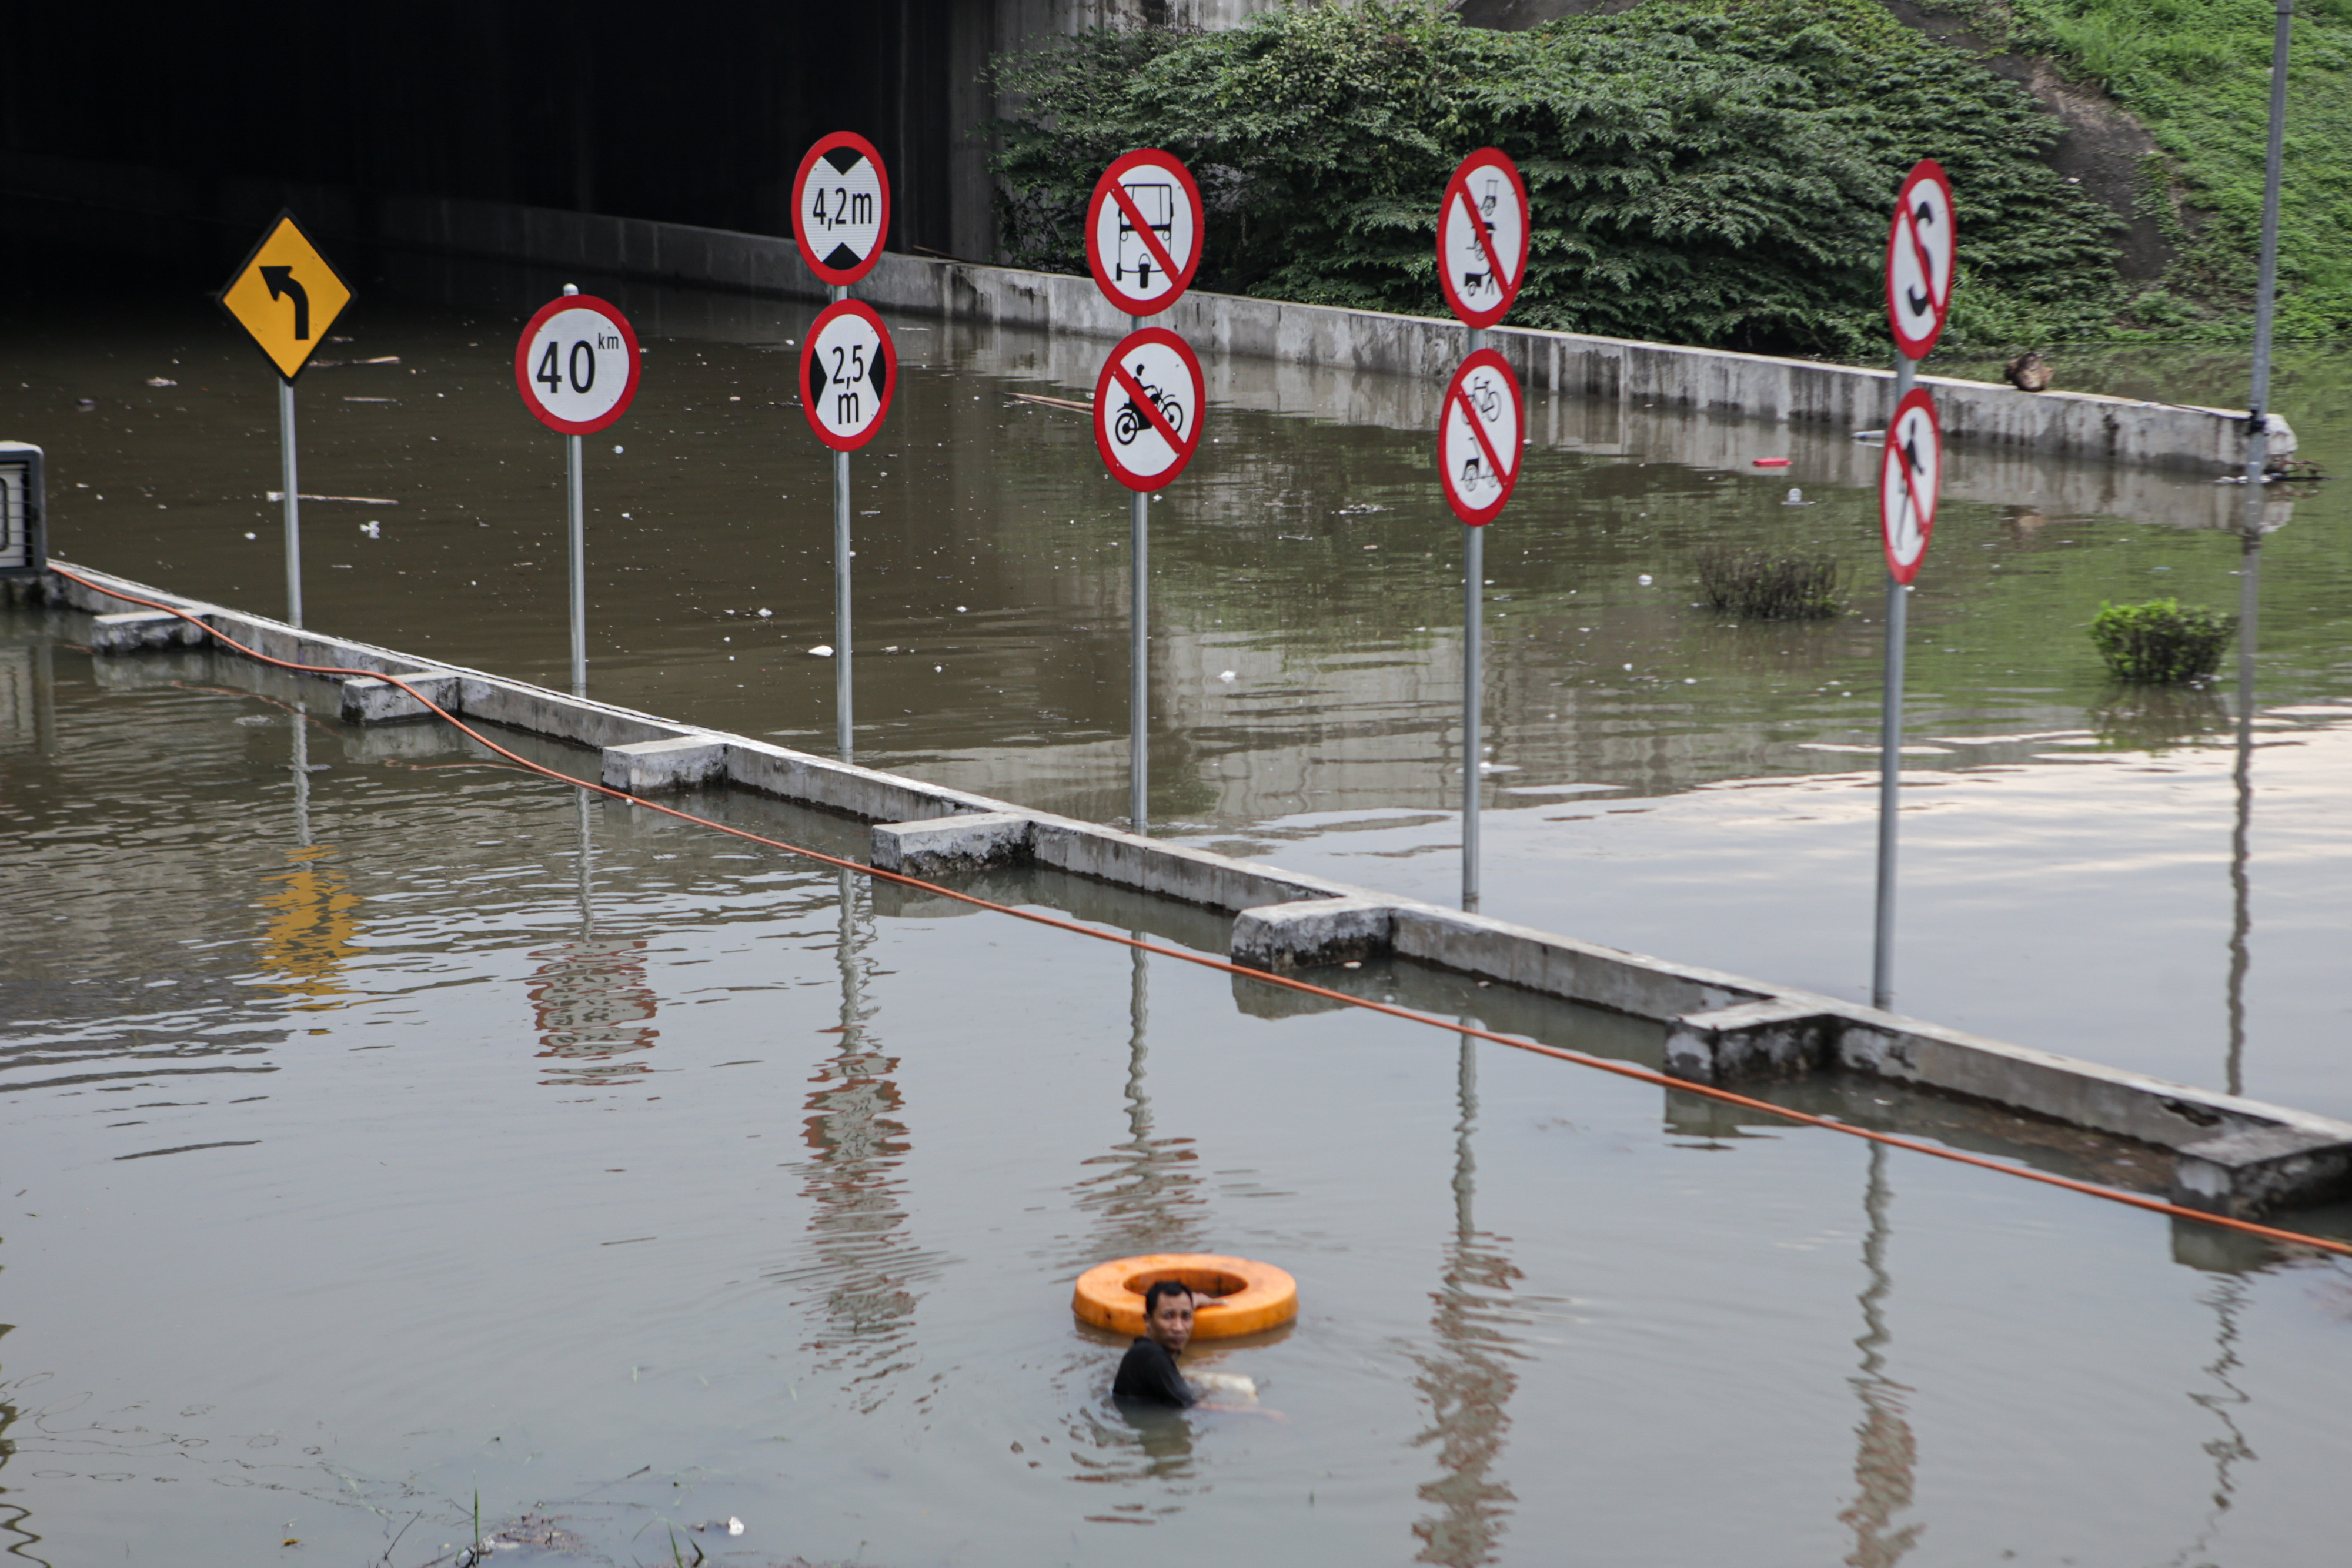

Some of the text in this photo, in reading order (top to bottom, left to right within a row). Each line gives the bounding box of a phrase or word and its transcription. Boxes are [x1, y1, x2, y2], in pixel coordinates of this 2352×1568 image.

[536, 332, 619, 394] 40 km
[832, 345, 864, 390] 2,5
[838, 392, 859, 425] m
